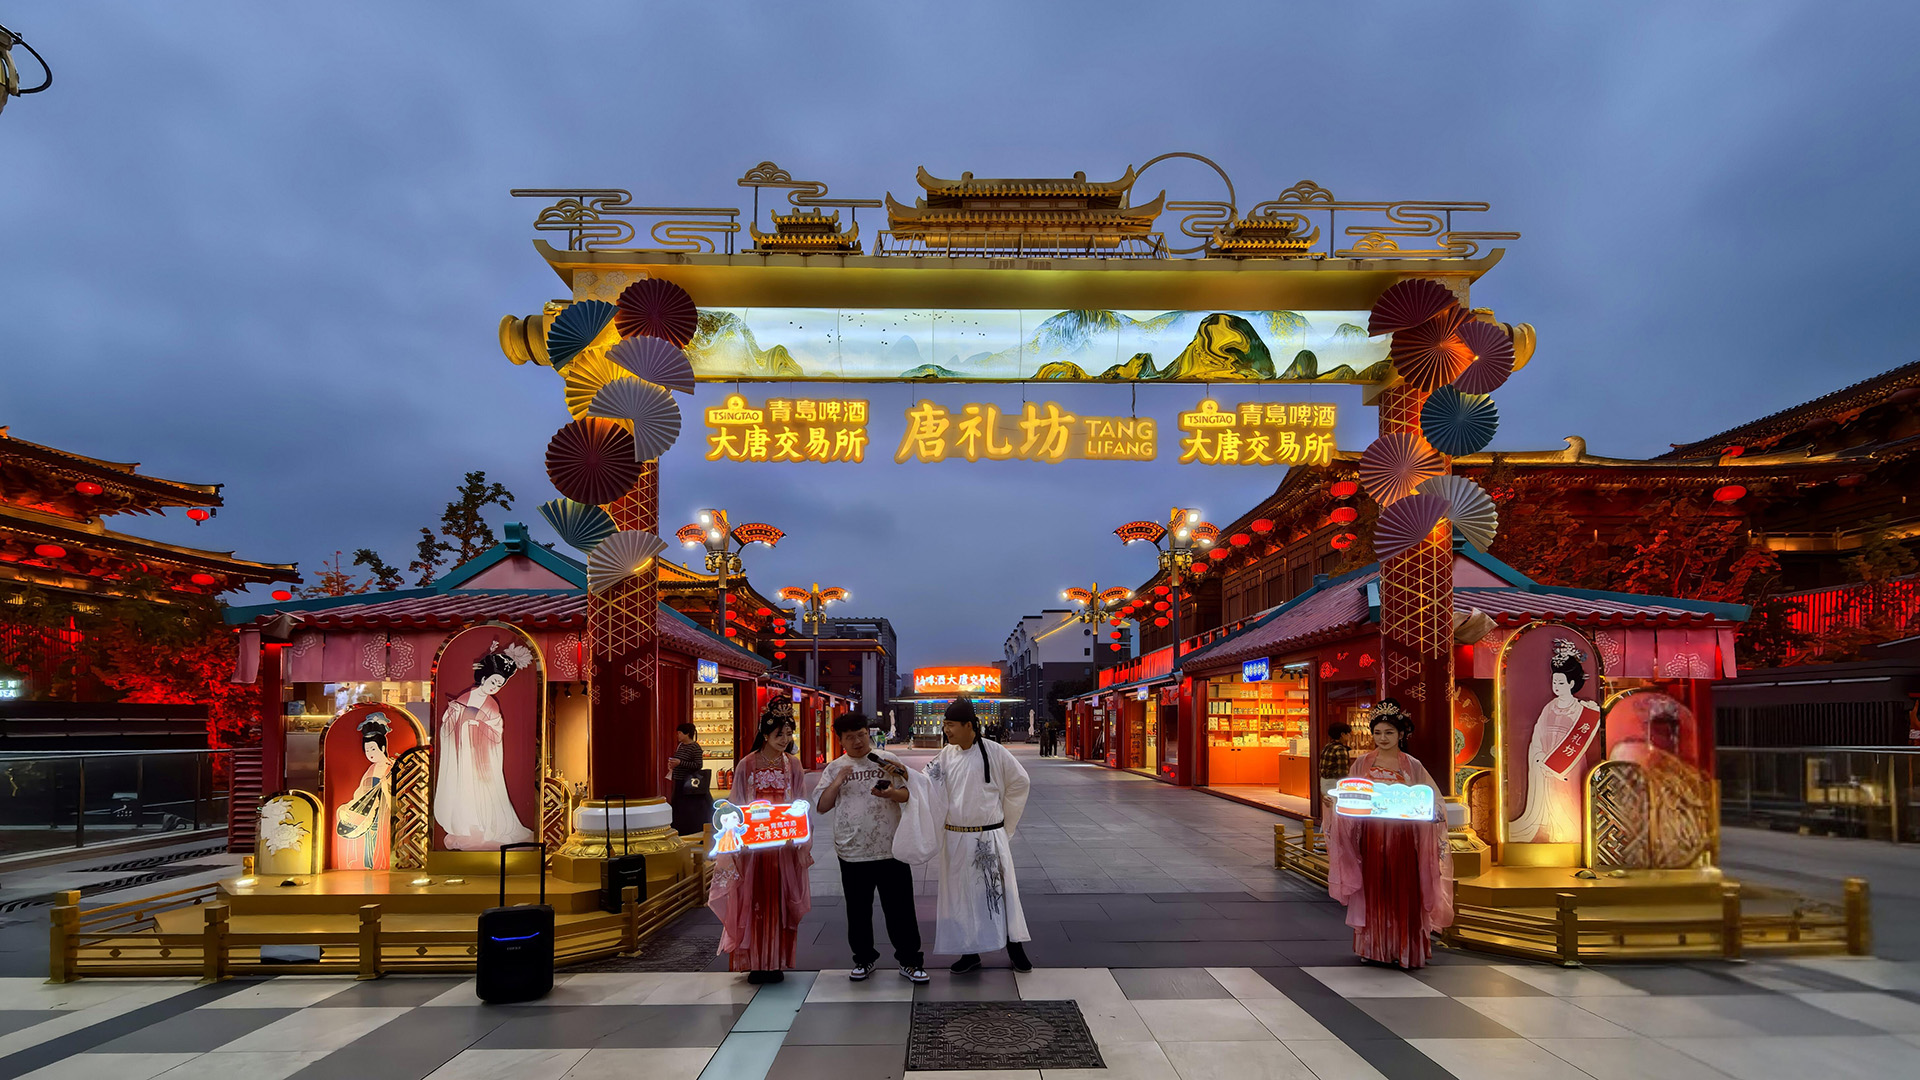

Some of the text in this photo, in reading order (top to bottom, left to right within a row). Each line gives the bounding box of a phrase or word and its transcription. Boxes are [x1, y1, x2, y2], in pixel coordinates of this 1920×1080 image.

[713, 411, 759, 421] TSINGTAO
[1187, 415, 1233, 424] TSINGTAO
[709, 425, 866, 460] 大唐交易所
[901, 403, 1076, 461] 唐礼坊
[1084, 420, 1154, 440] TANG
[1087, 441, 1153, 457] LIFANG
[1181, 429, 1334, 464] 大唐交易所
[1562, 722, 1590, 757] 唐礼坊
